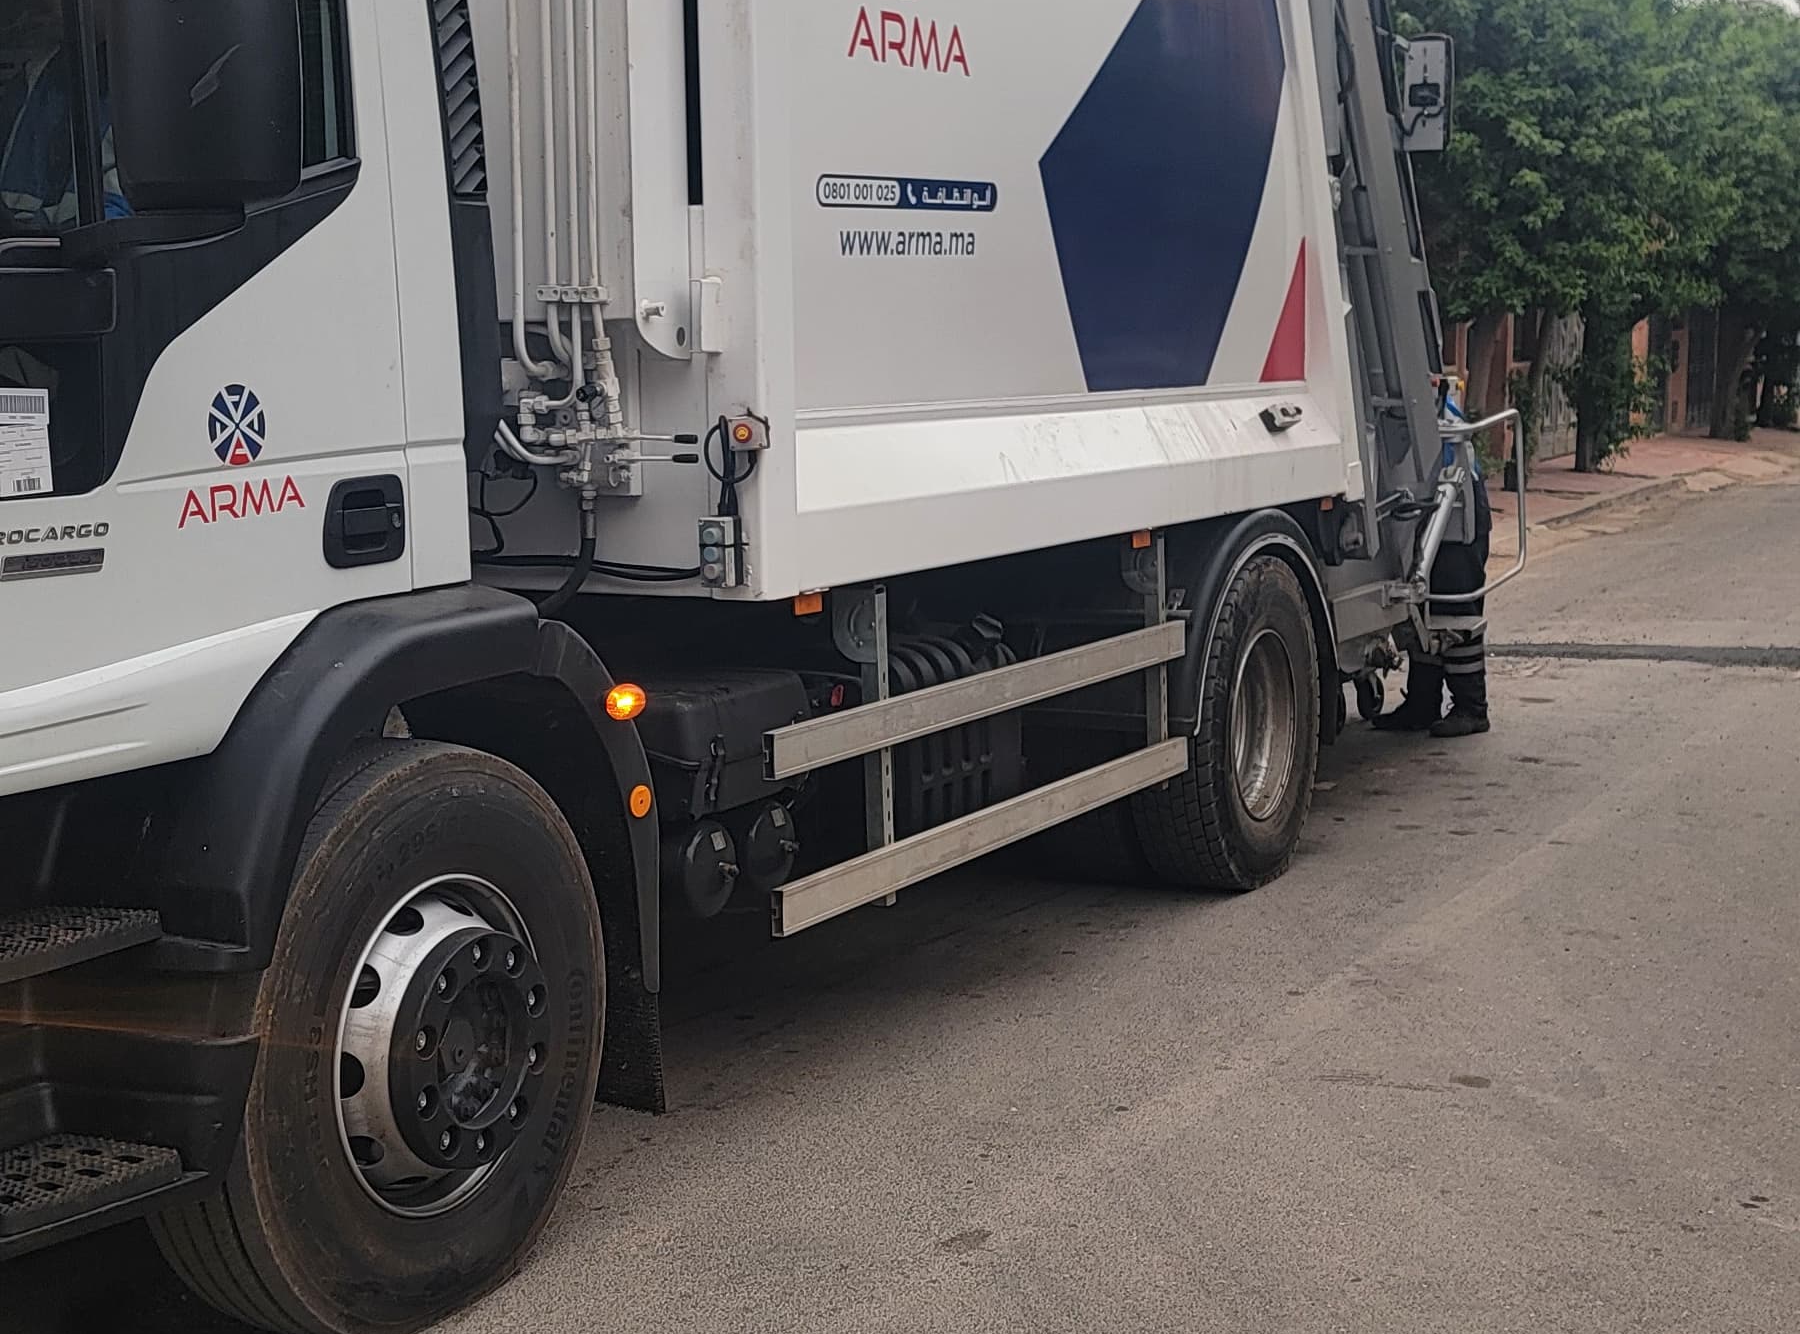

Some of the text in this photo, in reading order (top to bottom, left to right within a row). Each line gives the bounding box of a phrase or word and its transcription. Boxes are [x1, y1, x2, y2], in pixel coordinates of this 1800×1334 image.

[847, 5, 971, 77] ARMA
[823, 181, 897, 202] 0801 001 025
[839, 229, 976, 257] www.arma.ma
[177, 474, 306, 530] ARMA
